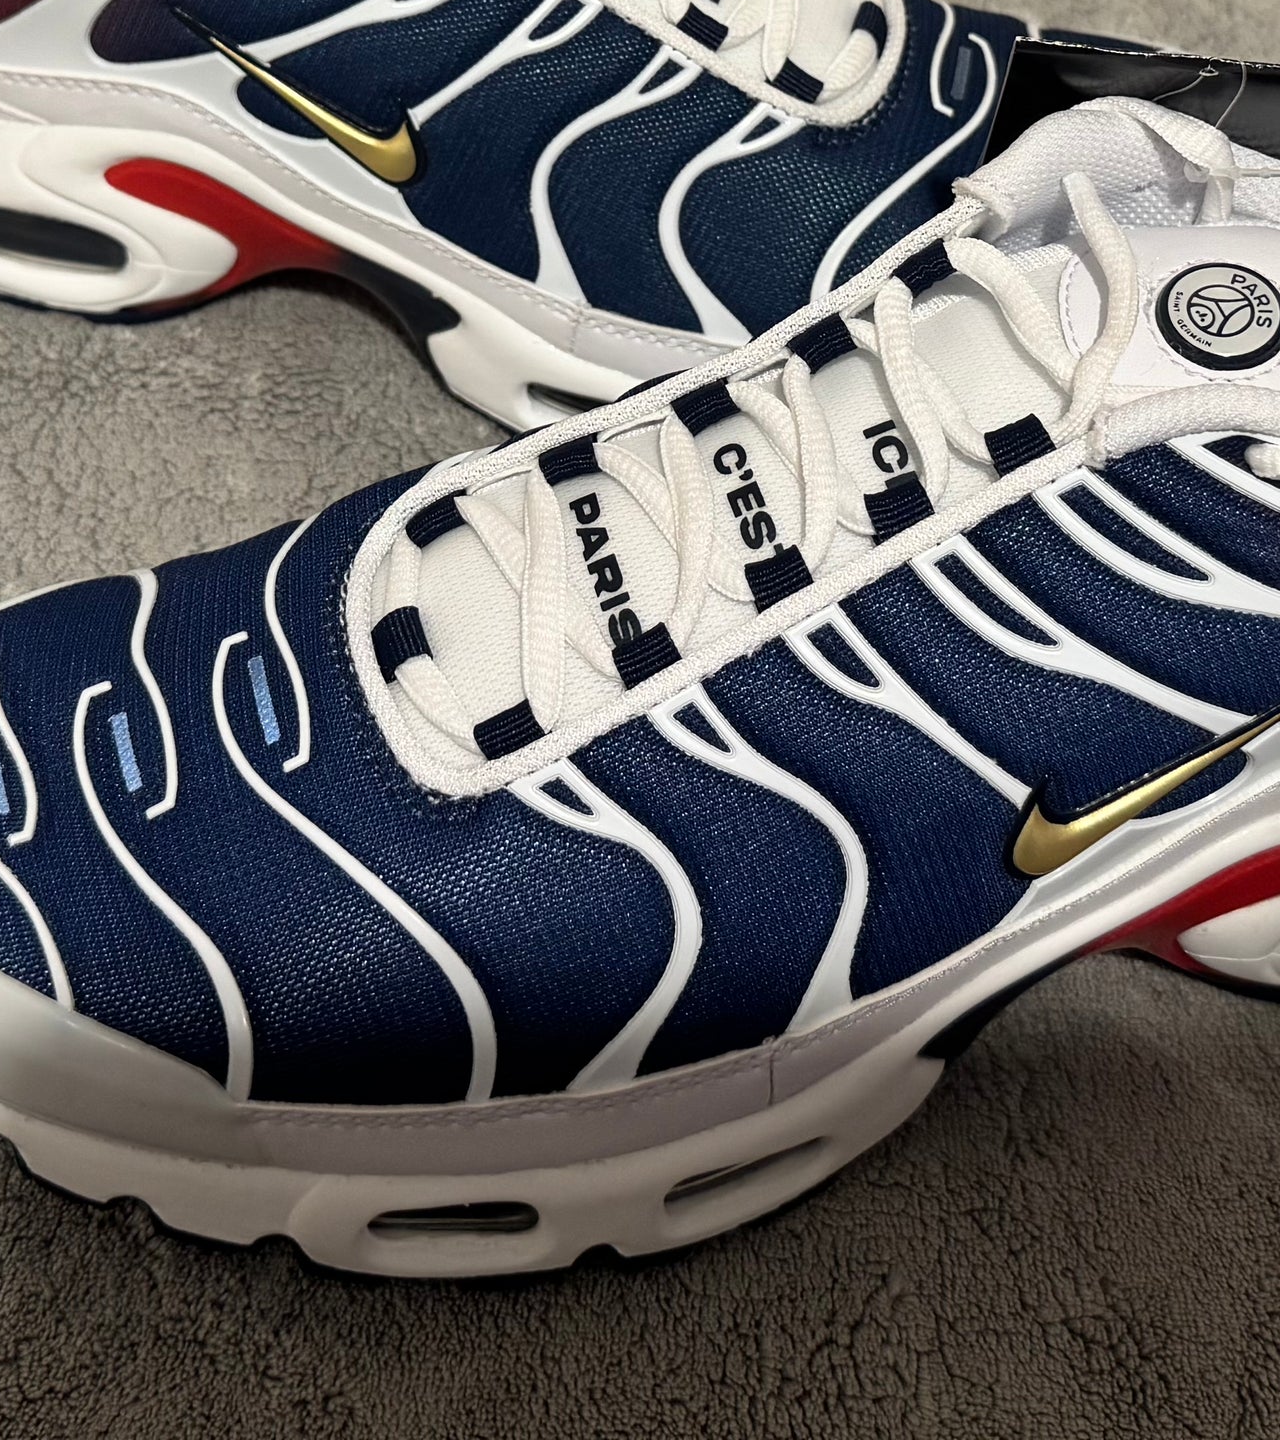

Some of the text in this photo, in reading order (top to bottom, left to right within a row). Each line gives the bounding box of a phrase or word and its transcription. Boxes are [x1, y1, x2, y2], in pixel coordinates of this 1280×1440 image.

[1173, 291, 1213, 348] SAINT GERMAIN
[1230, 273, 1274, 329] PARIS
[862, 419, 919, 489] ICI
[713, 442, 786, 558] C'ES
[569, 492, 642, 649] PARIS
